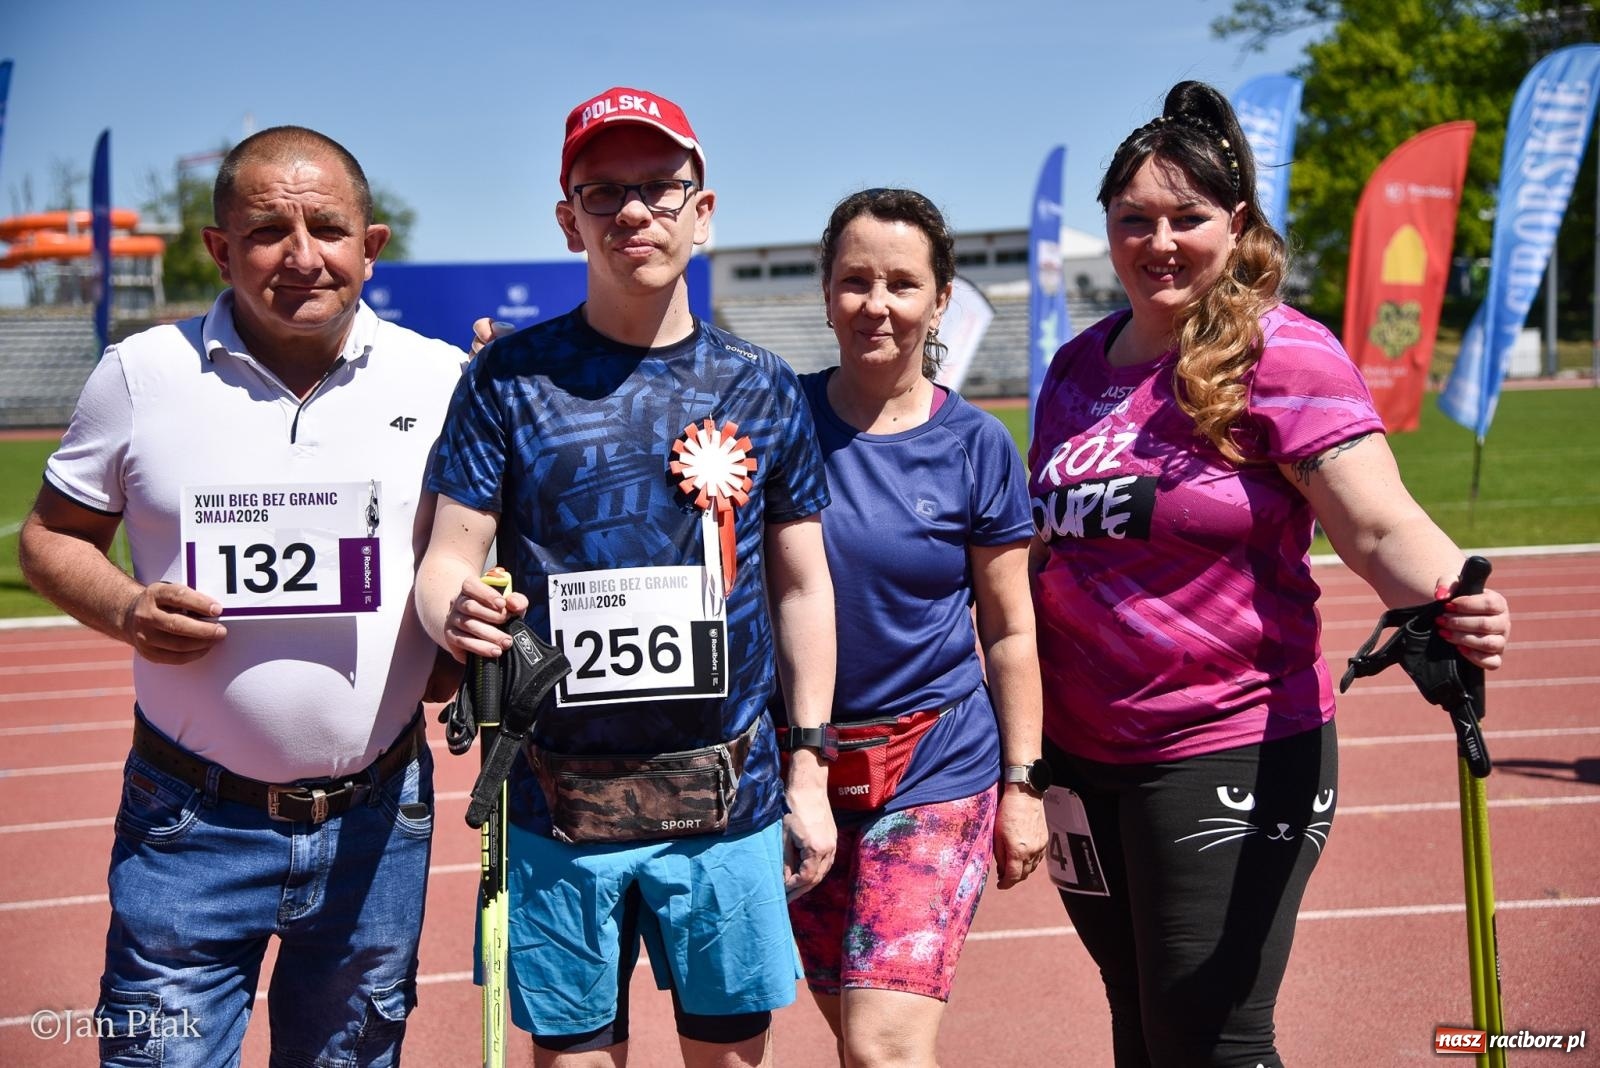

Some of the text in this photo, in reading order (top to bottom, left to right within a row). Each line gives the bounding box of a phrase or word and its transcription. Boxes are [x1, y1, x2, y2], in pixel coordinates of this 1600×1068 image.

[582, 95, 662, 129] POLSKA
[725, 344, 758, 361] DOMYOS
[1101, 386, 1136, 398] JUST
[1090, 400, 1129, 416] HERO
[389, 416, 417, 432] 4F
[1038, 422, 1139, 487] RÓŻ
[195, 491, 338, 508] XVIII BIEG BEZ GRANIC
[195, 509, 269, 525] 3MAJA2026
[218, 542, 318, 595] 132
[560, 575, 688, 597] XVIII BIEG BEZ GRANIC
[561, 594, 627, 612] 3MAJA2026
[574, 625, 682, 680] 256
[838, 784, 870, 796] SPORT
[661, 819, 702, 830] SPORT
